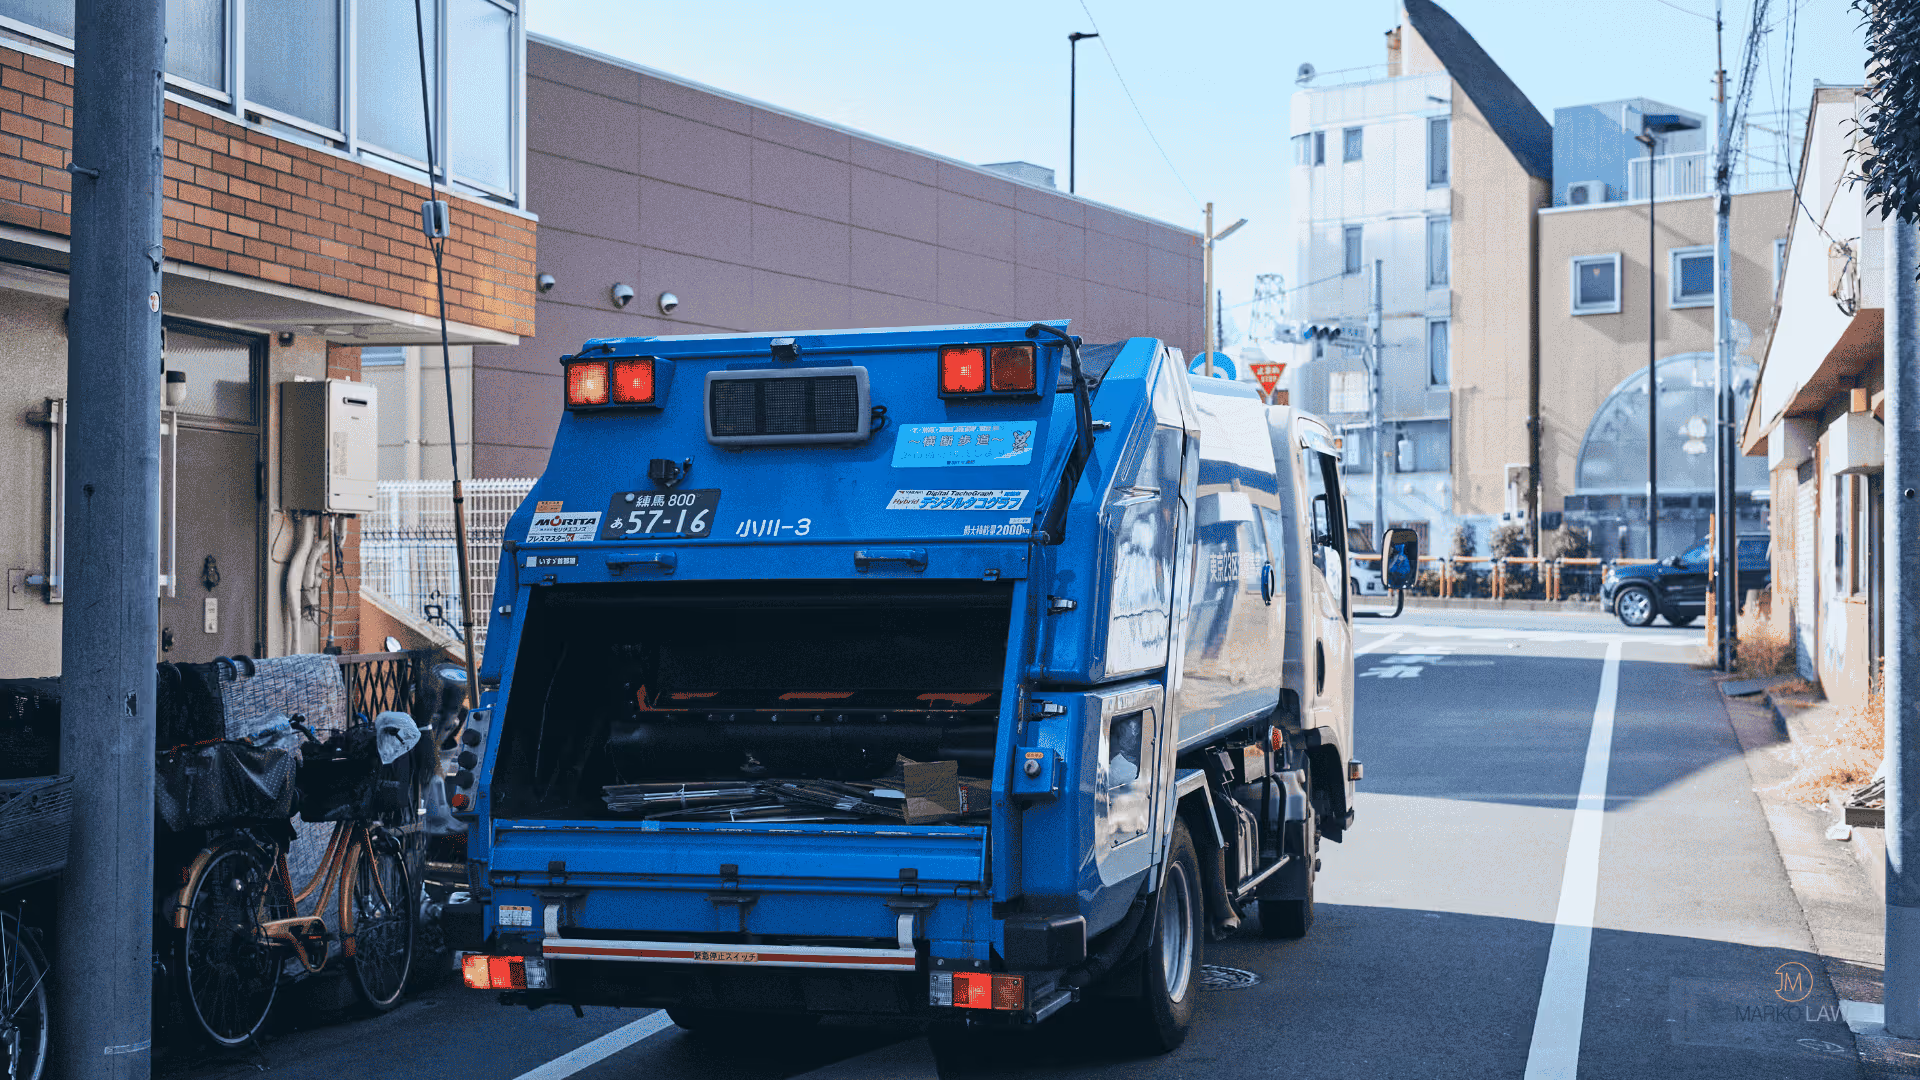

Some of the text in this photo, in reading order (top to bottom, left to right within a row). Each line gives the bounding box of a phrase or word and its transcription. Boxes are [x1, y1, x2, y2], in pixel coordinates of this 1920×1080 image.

[635, 493, 696, 508] 練馬 800
[919, 496, 1022, 509] デジタルタコグラフ
[535, 516, 596, 526] MORITA
[610, 508, 710, 534] あ 57-16
[694, 951, 757, 962] 緊急停止スイッチ
